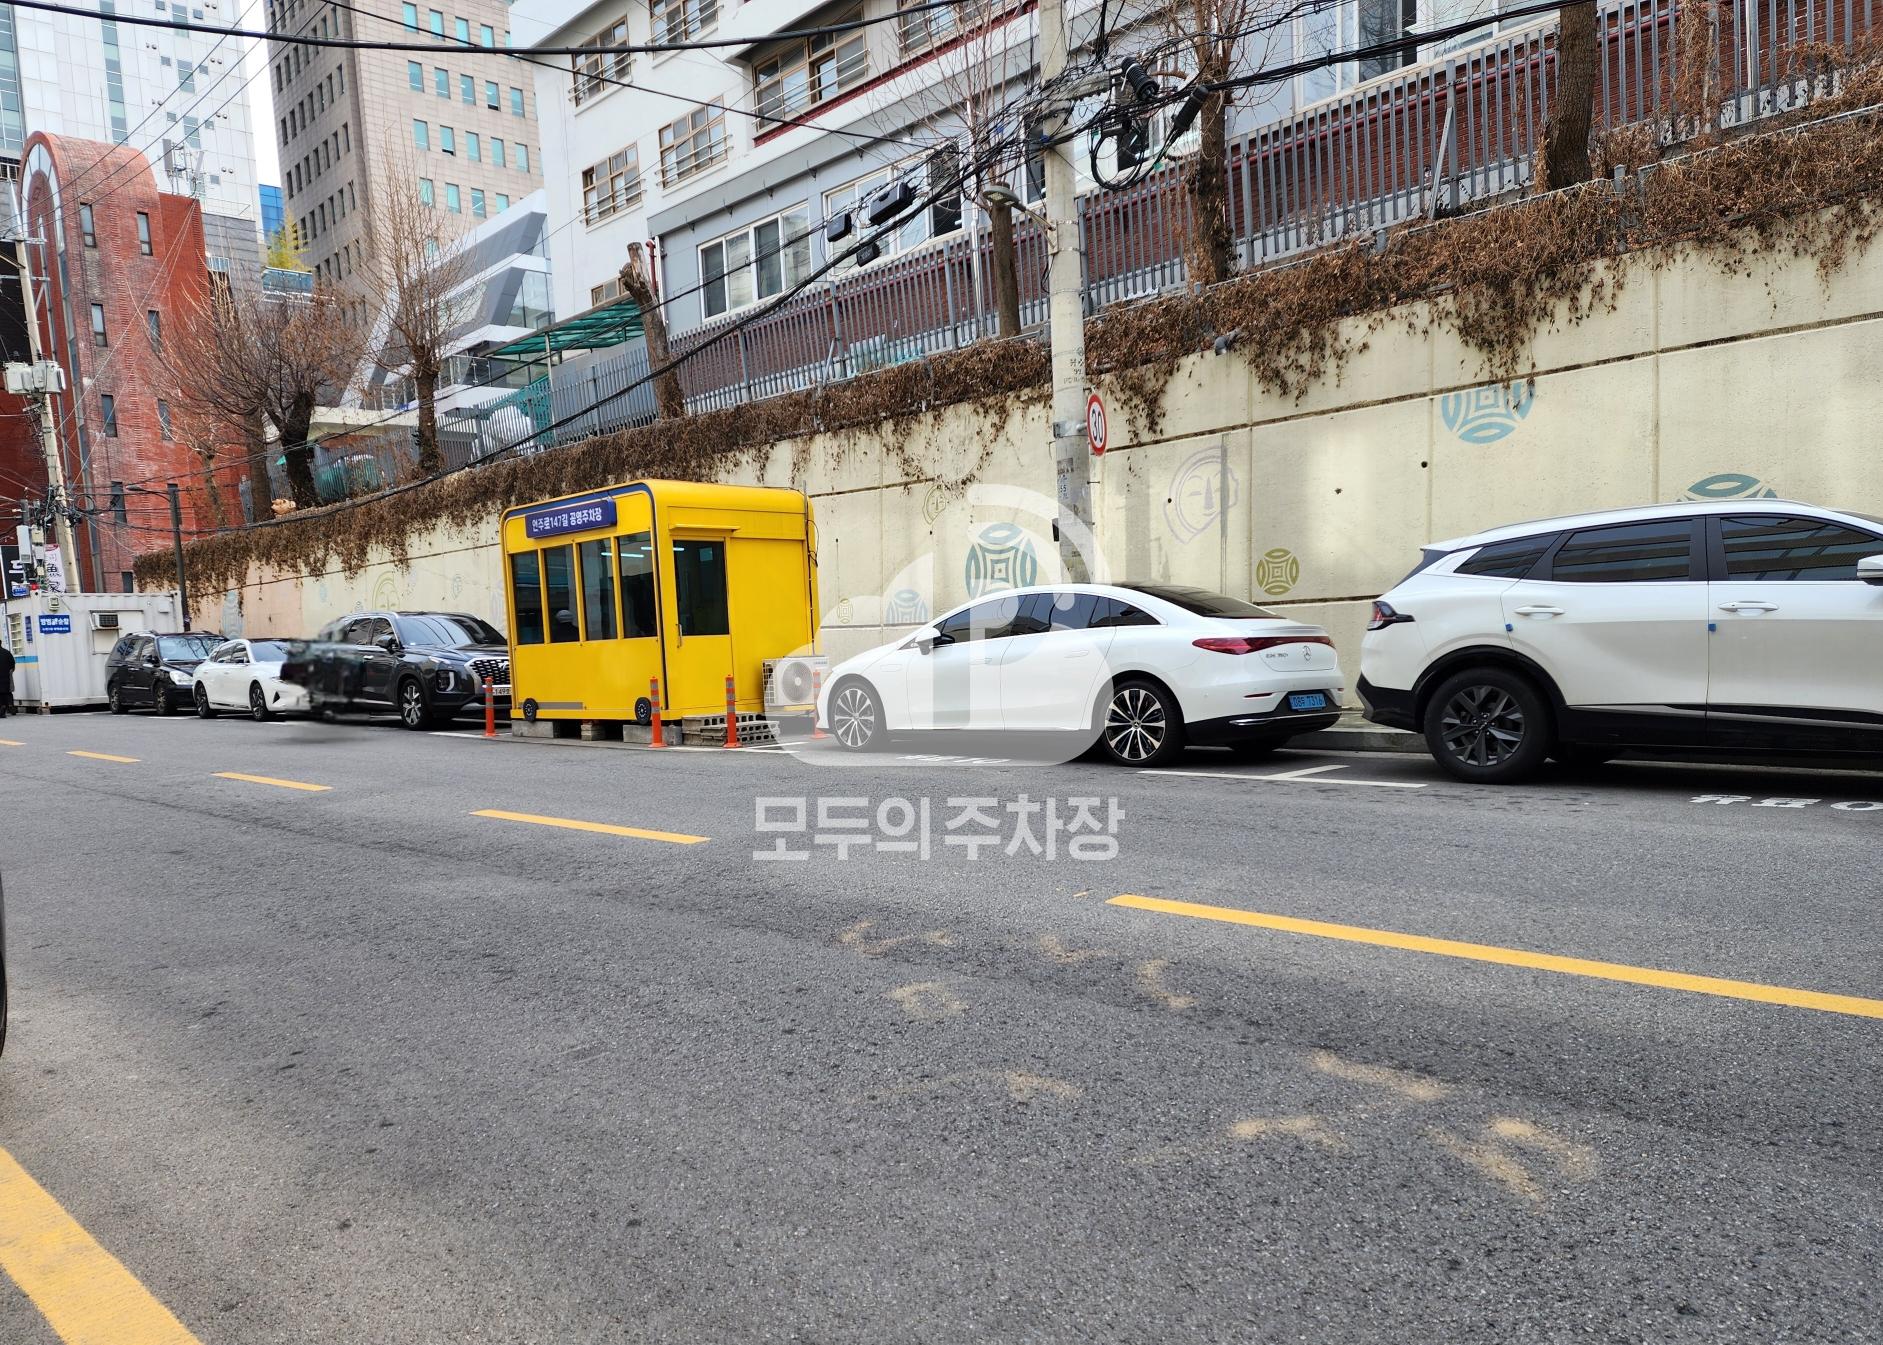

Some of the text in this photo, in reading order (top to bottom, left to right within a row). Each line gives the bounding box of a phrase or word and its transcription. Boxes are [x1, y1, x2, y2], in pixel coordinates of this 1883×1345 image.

[1092, 408, 1103, 443] 30
[531, 507, 602, 532] 언주로147길 공영주차장
